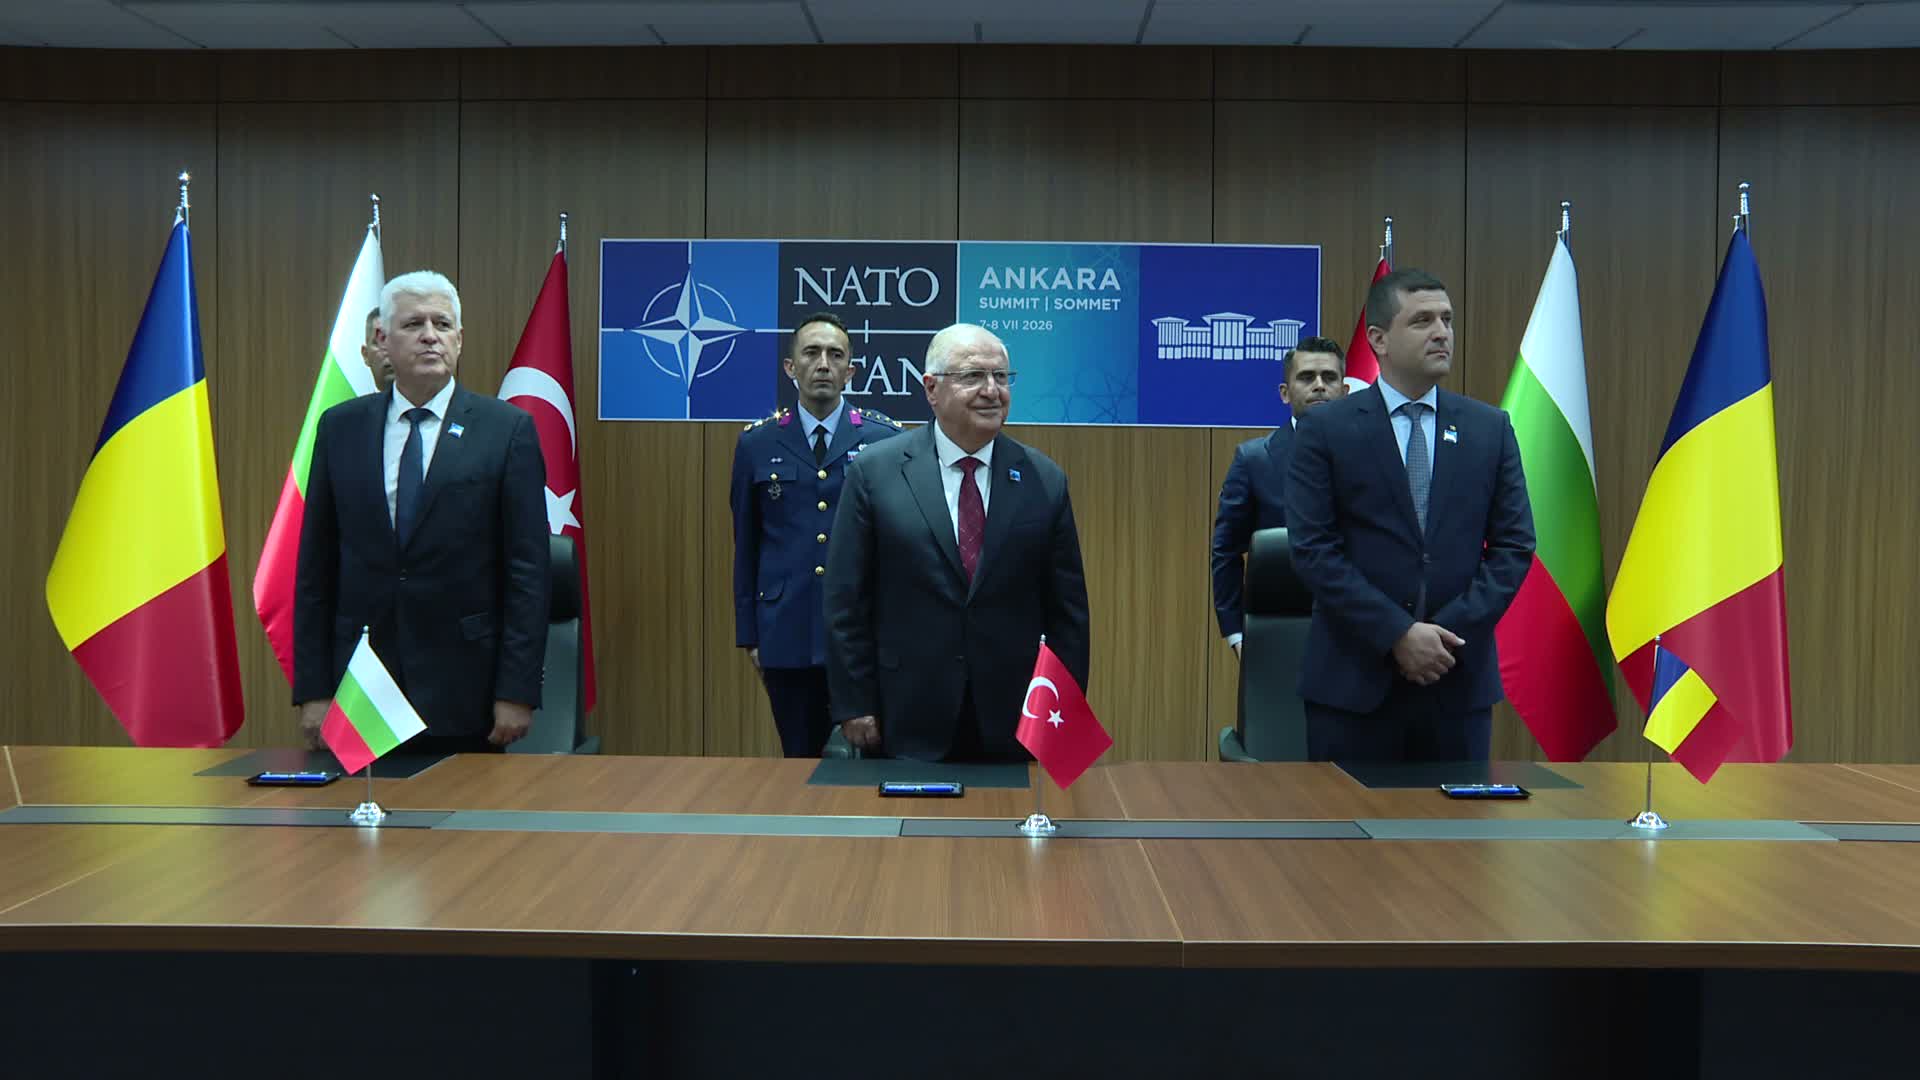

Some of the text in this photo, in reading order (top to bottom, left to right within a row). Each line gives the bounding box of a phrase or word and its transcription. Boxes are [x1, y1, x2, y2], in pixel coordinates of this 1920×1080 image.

[793, 265, 940, 307] NATO
[979, 266, 1121, 290] ANKARA
[979, 297, 1040, 310] SUMMIT
[1054, 298, 1121, 311] SOMMET
[979, 319, 1053, 331] 7-8 VII 2026
[793, 355, 925, 396] TAN
